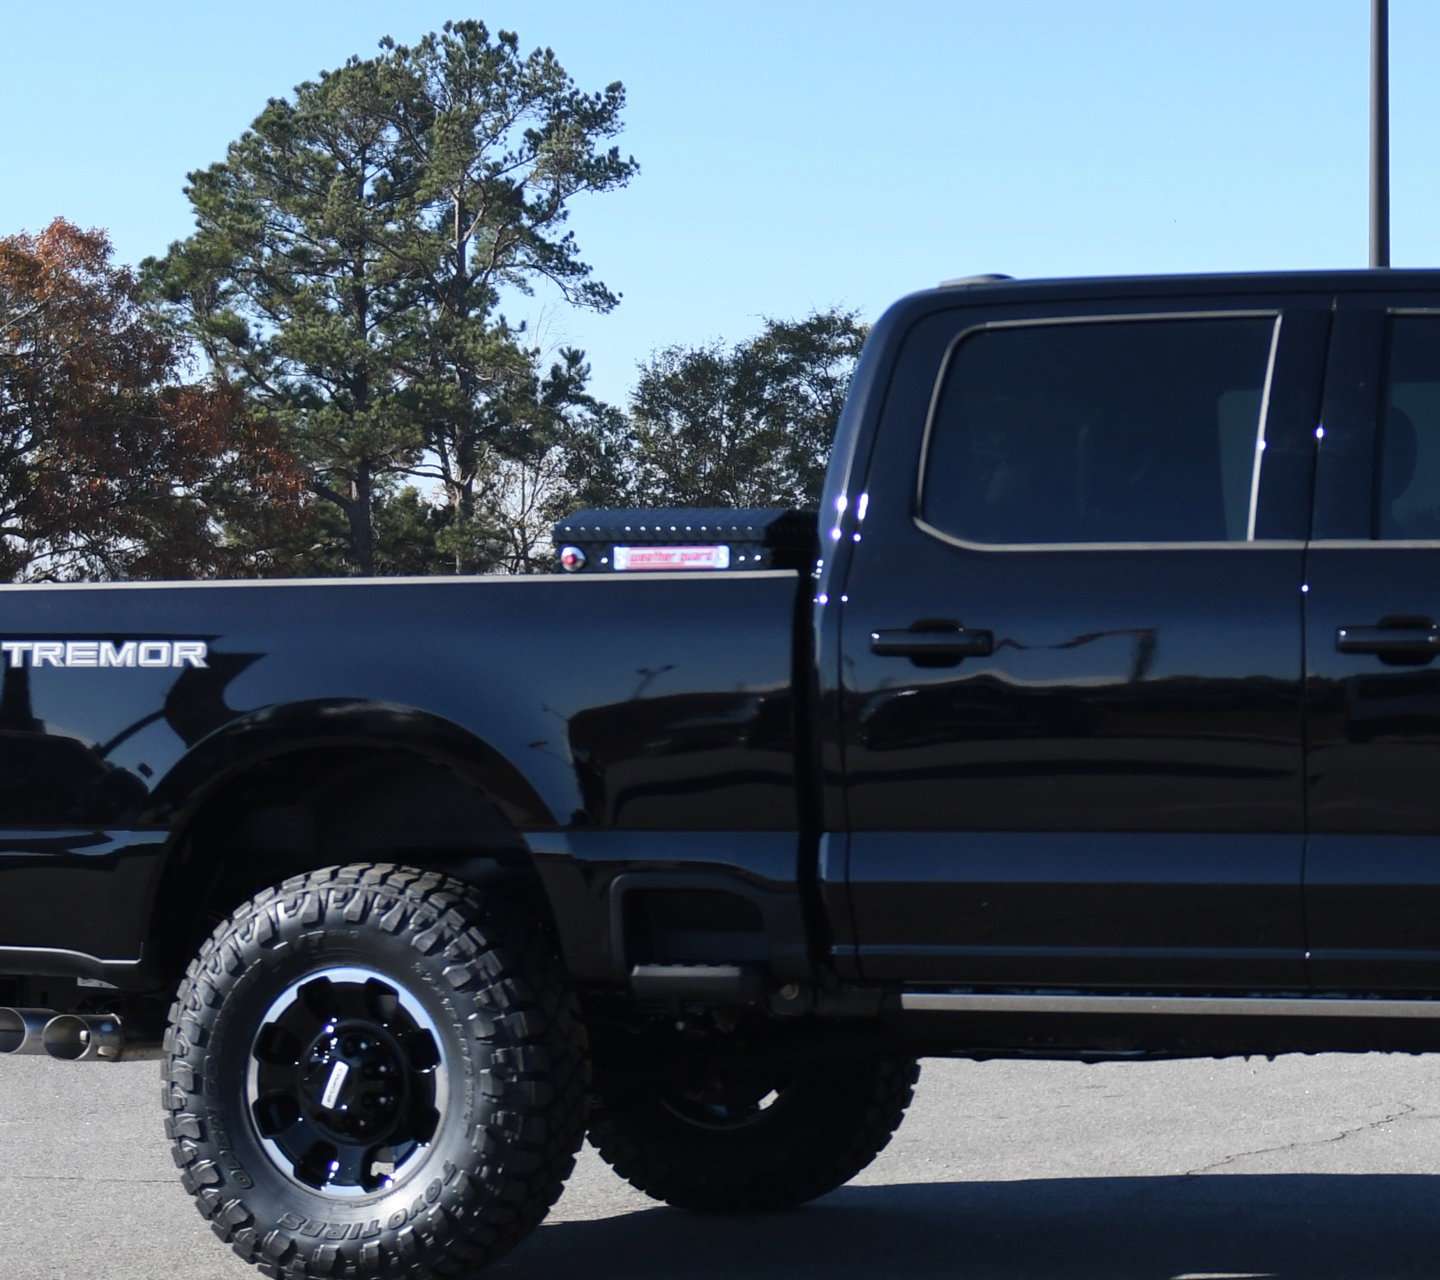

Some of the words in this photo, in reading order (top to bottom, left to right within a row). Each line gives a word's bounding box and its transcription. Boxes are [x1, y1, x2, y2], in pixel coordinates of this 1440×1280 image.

[0, 641, 210, 668] TREMOR
[388, 1159, 457, 1231] TOYO
[276, 1211, 382, 1240] TIRES
